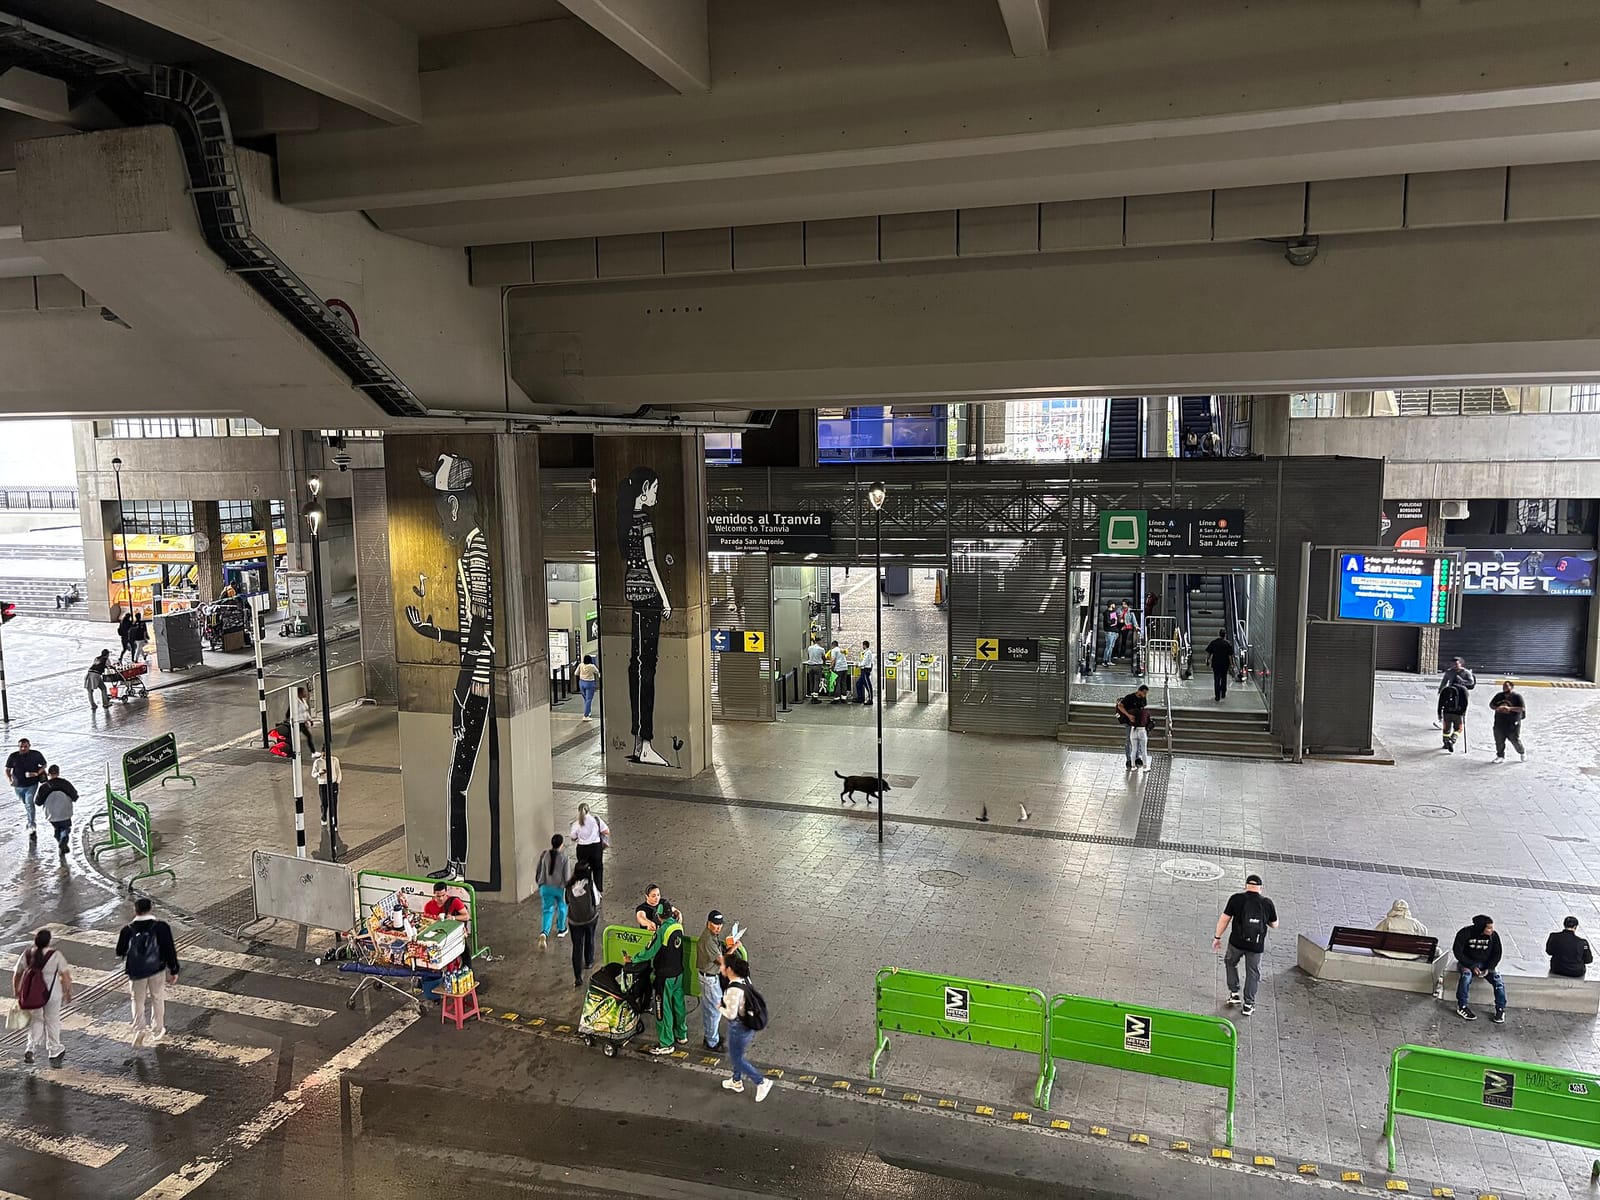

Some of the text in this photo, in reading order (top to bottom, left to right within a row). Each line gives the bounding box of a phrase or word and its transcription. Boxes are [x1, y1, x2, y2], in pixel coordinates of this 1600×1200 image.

[758, 513, 769, 525] al
[773, 513, 821, 525] Tranvía
[1148, 539, 1171, 547] Niquía
[1199, 539, 1238, 547] San Javier
[1346, 557, 1358, 571] A
[1364, 564, 1422, 575] San Antonio
[1007, 646, 1028, 654] Salida
[947, 1008, 967, 1016] METRO
[1127, 1038, 1149, 1046] METRO
[1485, 1095, 1511, 1104] METRO
